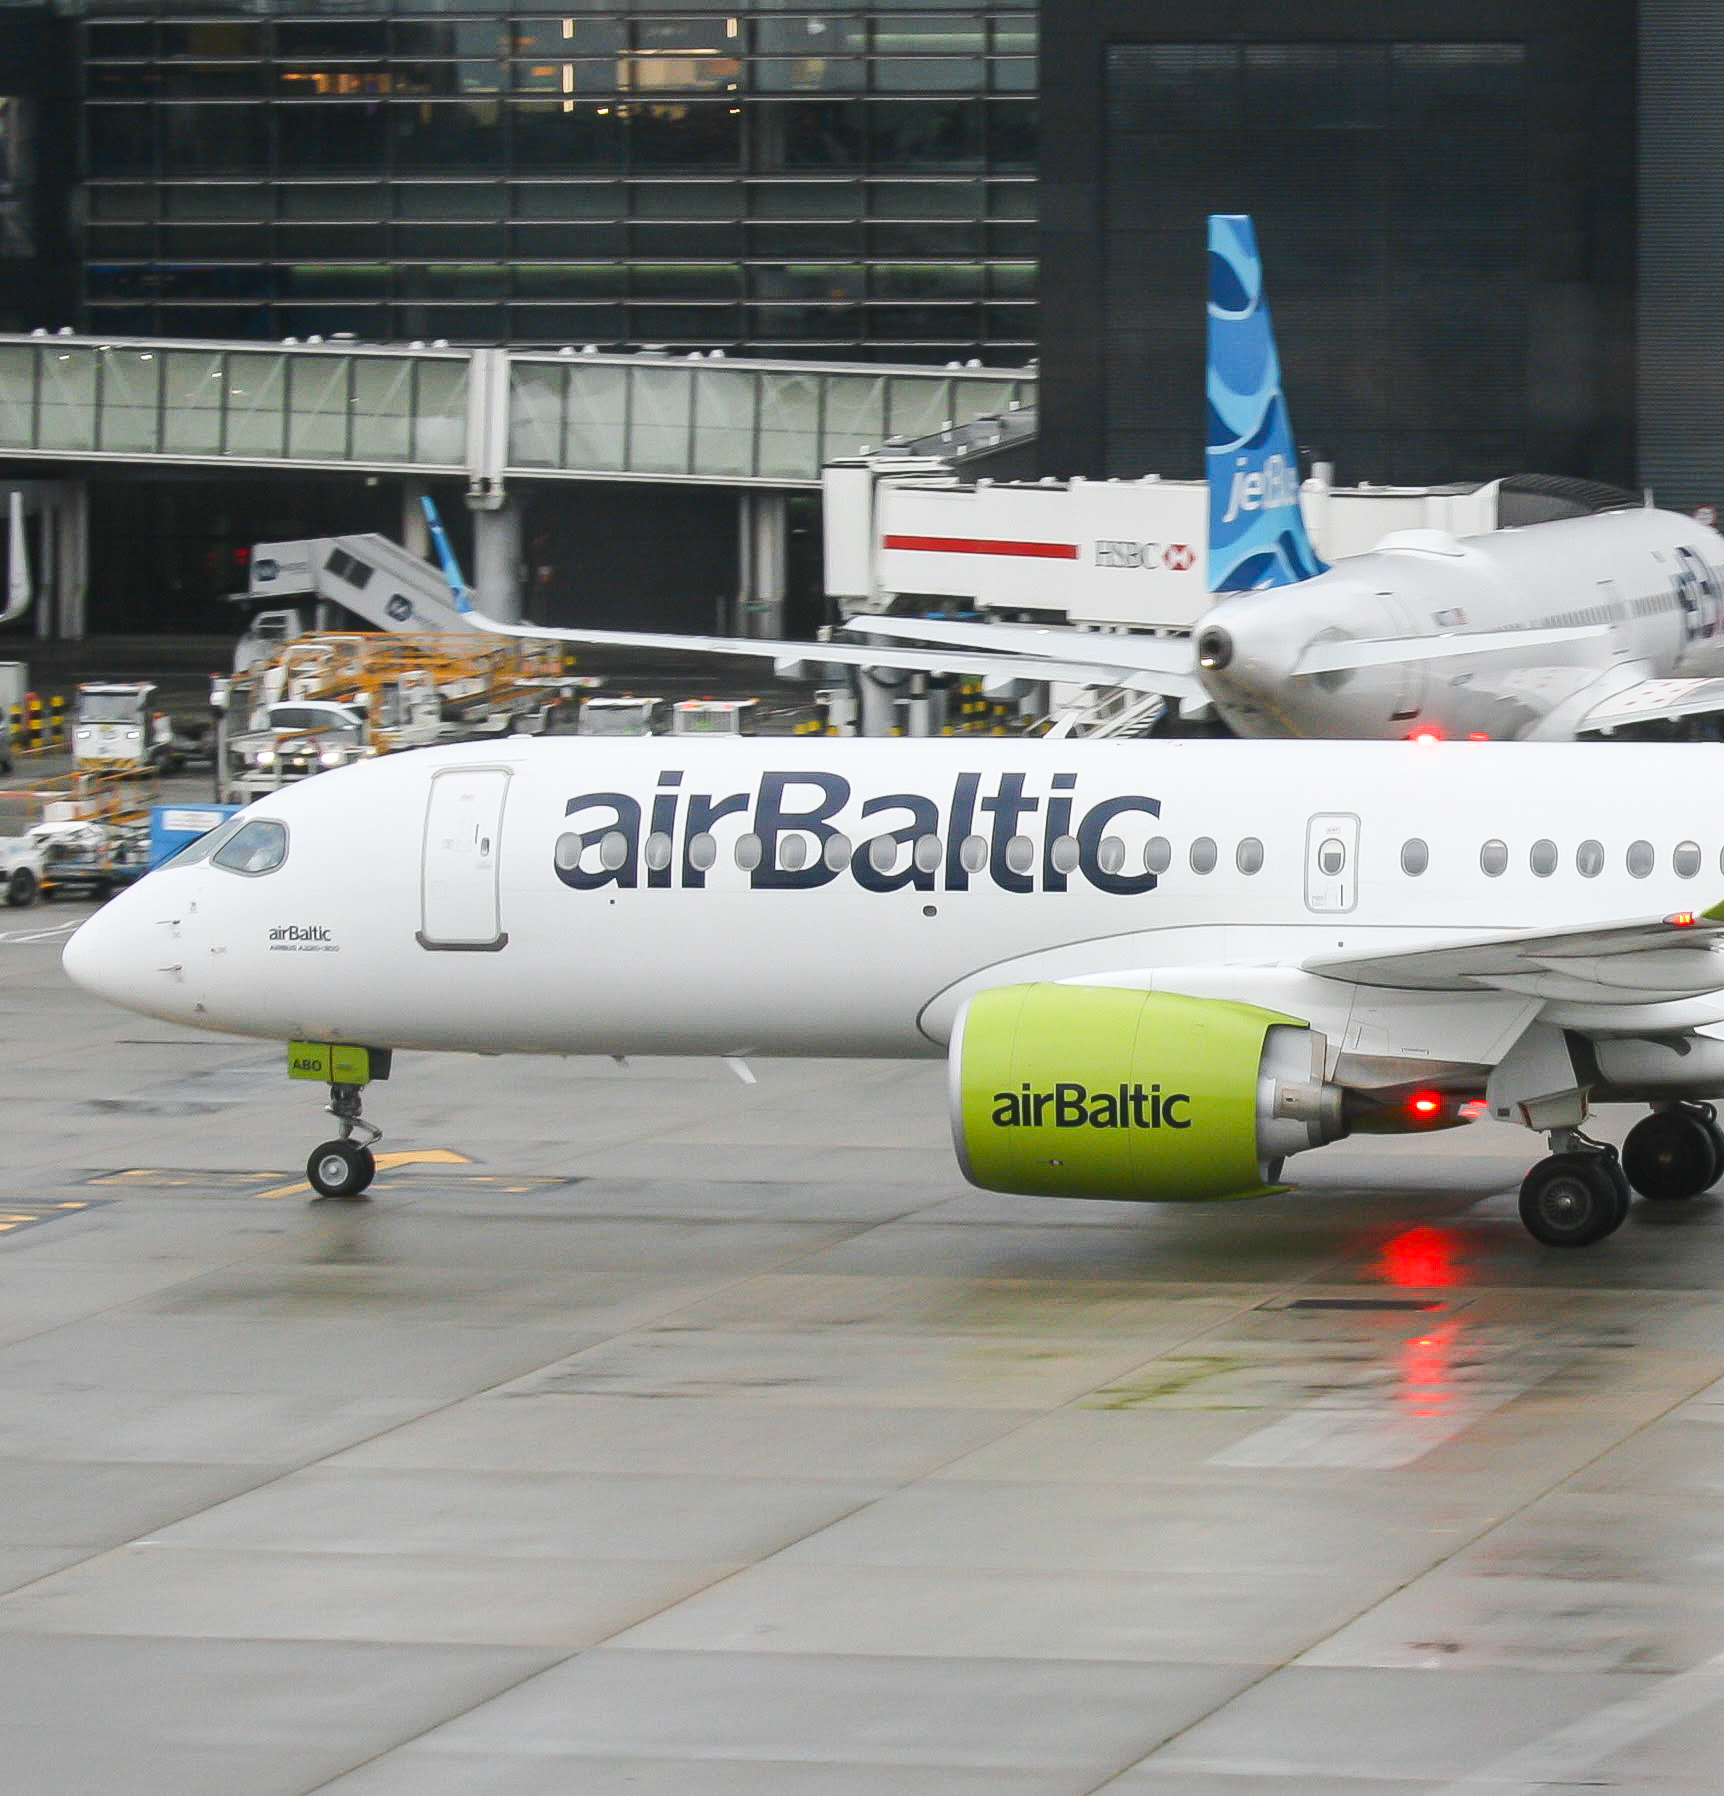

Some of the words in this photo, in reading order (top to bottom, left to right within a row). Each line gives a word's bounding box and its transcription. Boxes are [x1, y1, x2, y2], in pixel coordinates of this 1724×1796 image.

[1094, 540, 1161, 569] HSBC
[554, 770, 1163, 896] airBaltic
[268, 925, 332, 941] airBaltic
[293, 1059, 322, 1072] ABO
[991, 1083, 1192, 1128] airBaltic
